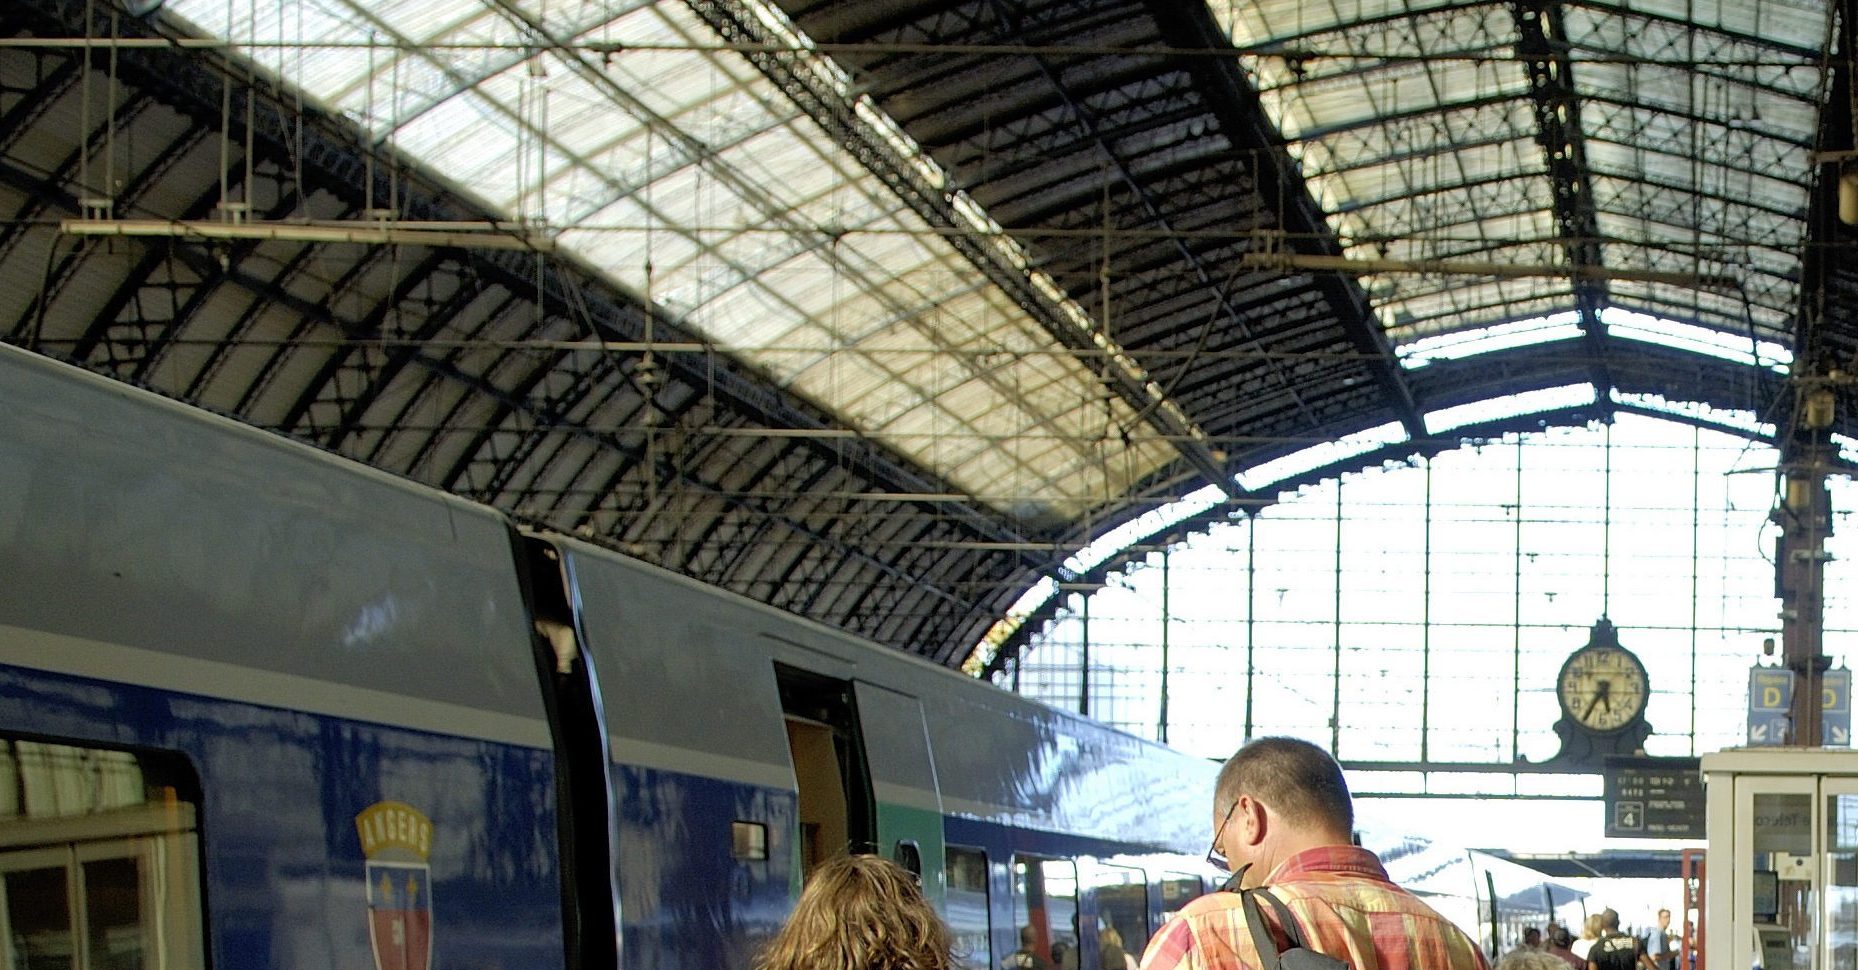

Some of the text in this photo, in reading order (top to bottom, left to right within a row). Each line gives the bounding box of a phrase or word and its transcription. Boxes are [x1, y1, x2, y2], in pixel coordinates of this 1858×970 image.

[1763, 687, 1781, 707] D
[1623, 813, 1635, 826] 4
[363, 808, 430, 852] ANGERS
